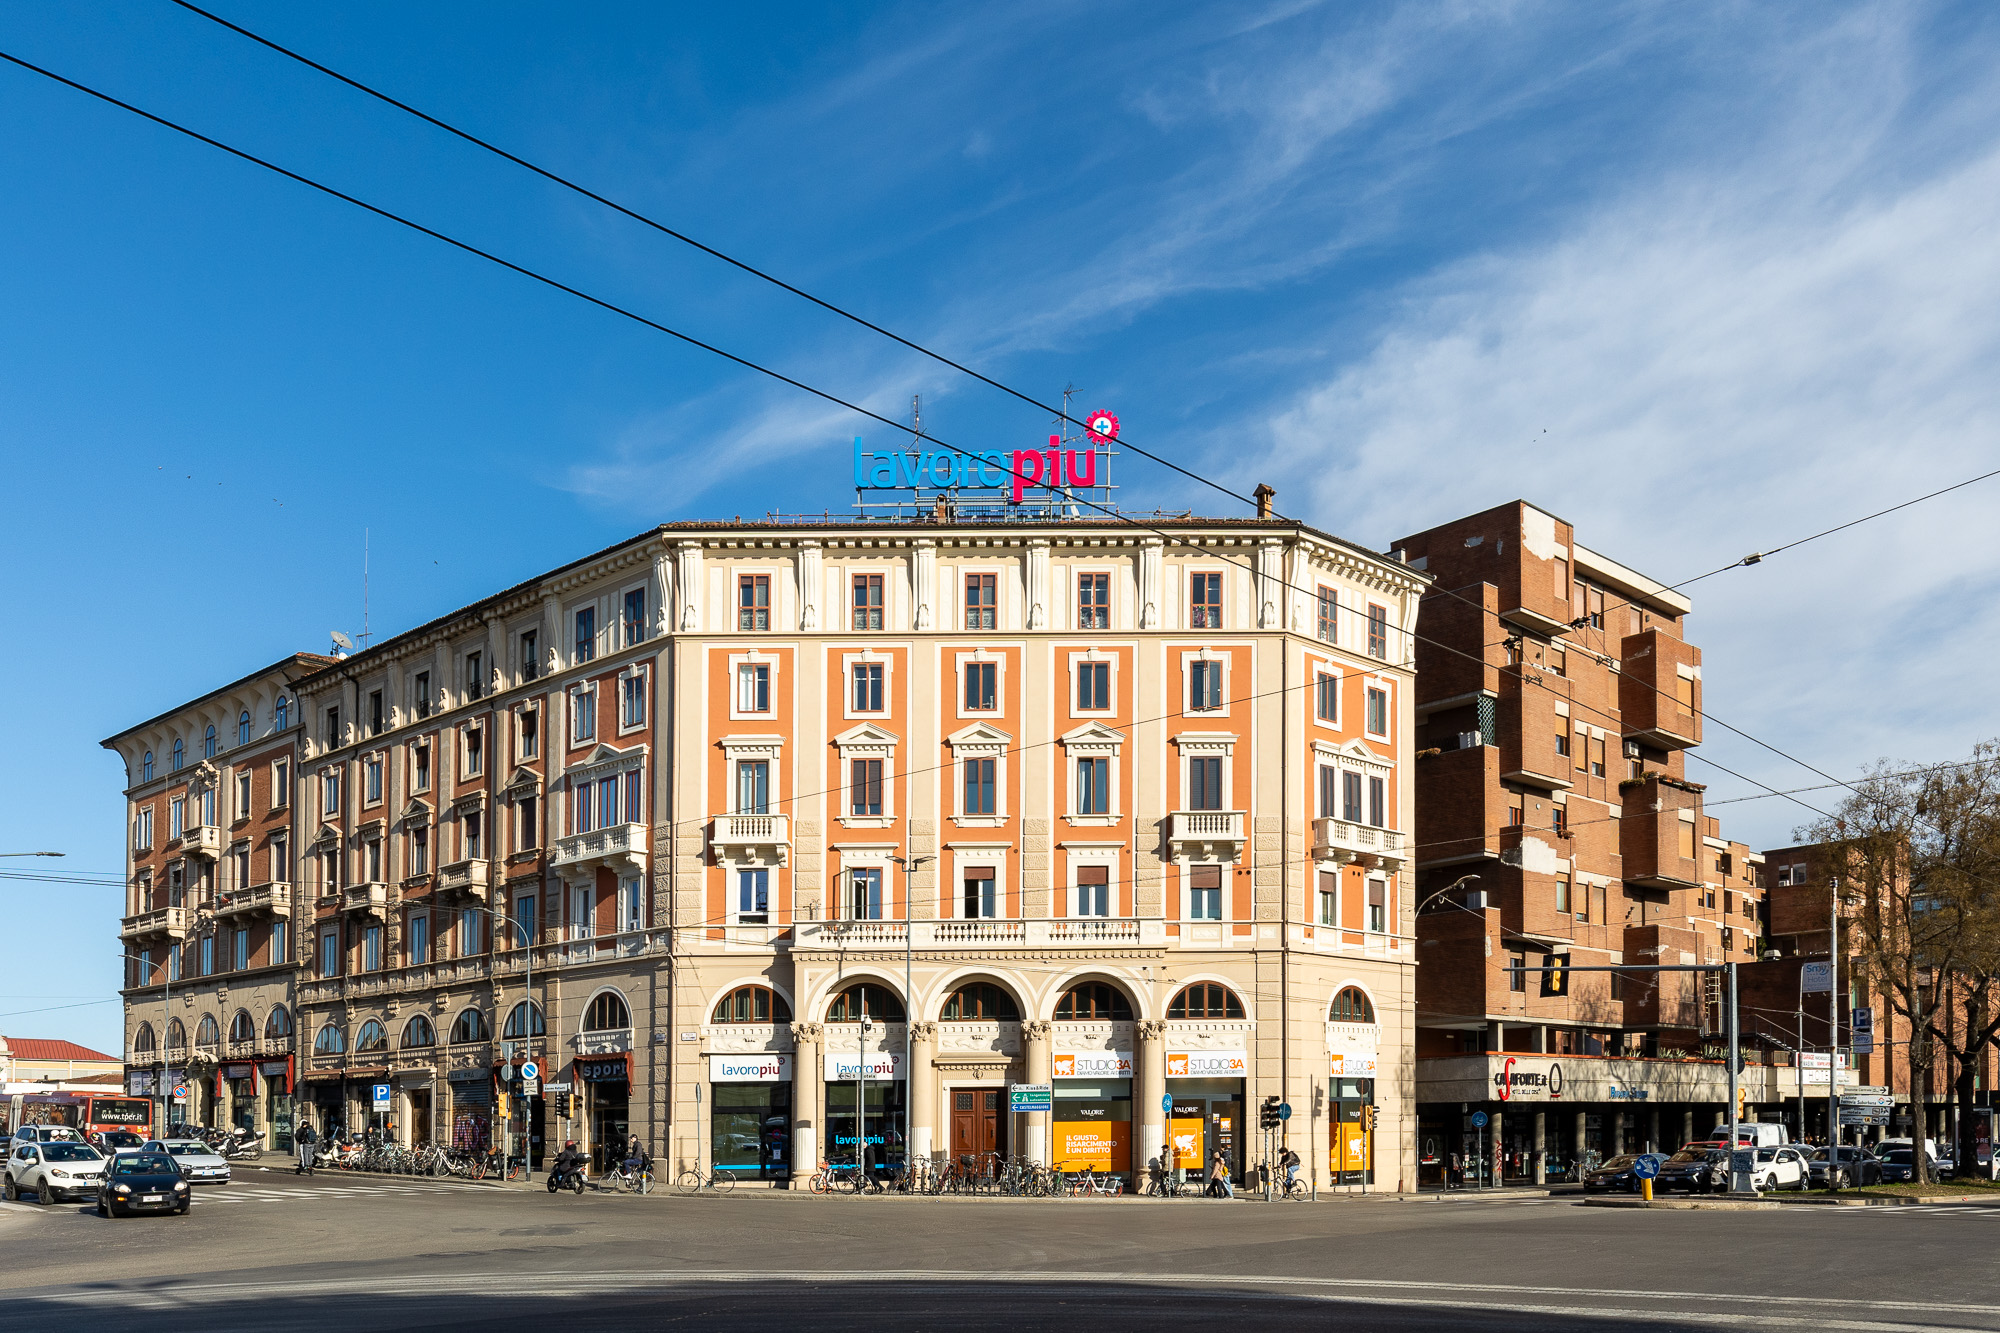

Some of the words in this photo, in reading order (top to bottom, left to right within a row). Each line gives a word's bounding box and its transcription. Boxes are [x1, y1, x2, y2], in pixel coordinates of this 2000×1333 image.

[853, 435, 1096, 502] lavoropiu
[1856, 1009, 1869, 1026] P
[583, 1062, 627, 1079] sport
[722, 1063, 780, 1078] lavoropiu
[376, 1086, 387, 1099] P
